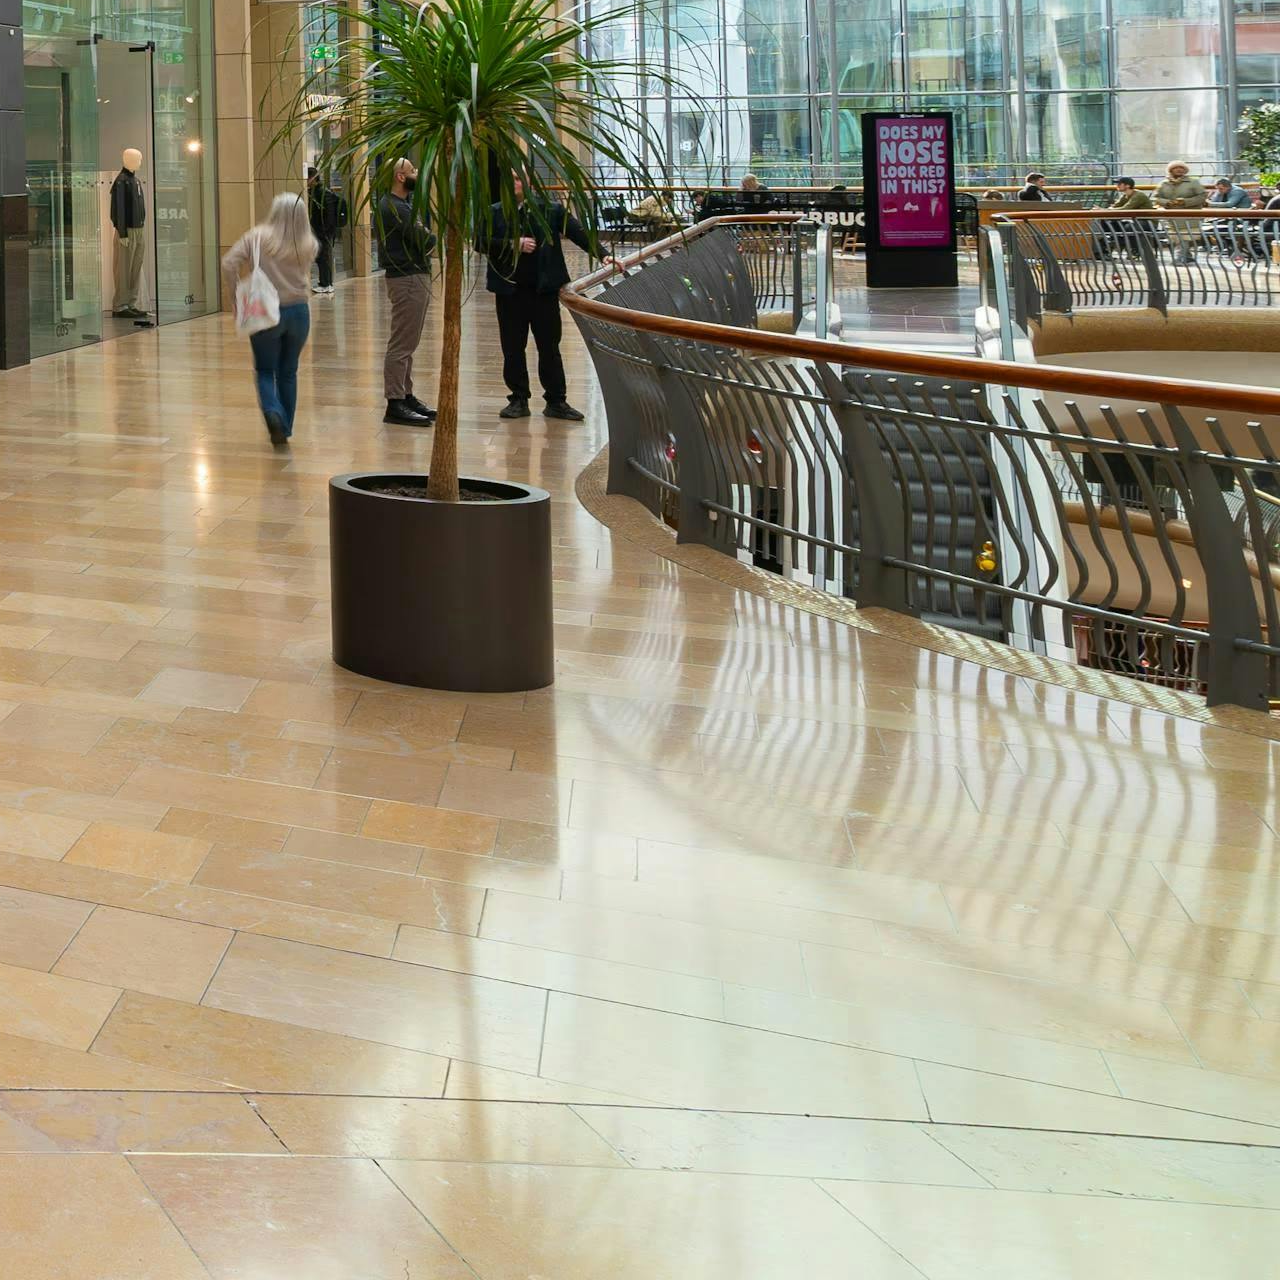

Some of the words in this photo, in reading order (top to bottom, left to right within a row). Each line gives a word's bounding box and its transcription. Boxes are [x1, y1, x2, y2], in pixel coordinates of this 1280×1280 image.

[880, 126, 918, 140] DOES
[921, 126, 944, 140] MY
[880, 141, 946, 164] NOSE
[881, 166, 917, 178] LOOK
[920, 165, 946, 178] RED
[881, 180, 898, 194] IN
[901, 179, 946, 194] THIS?
